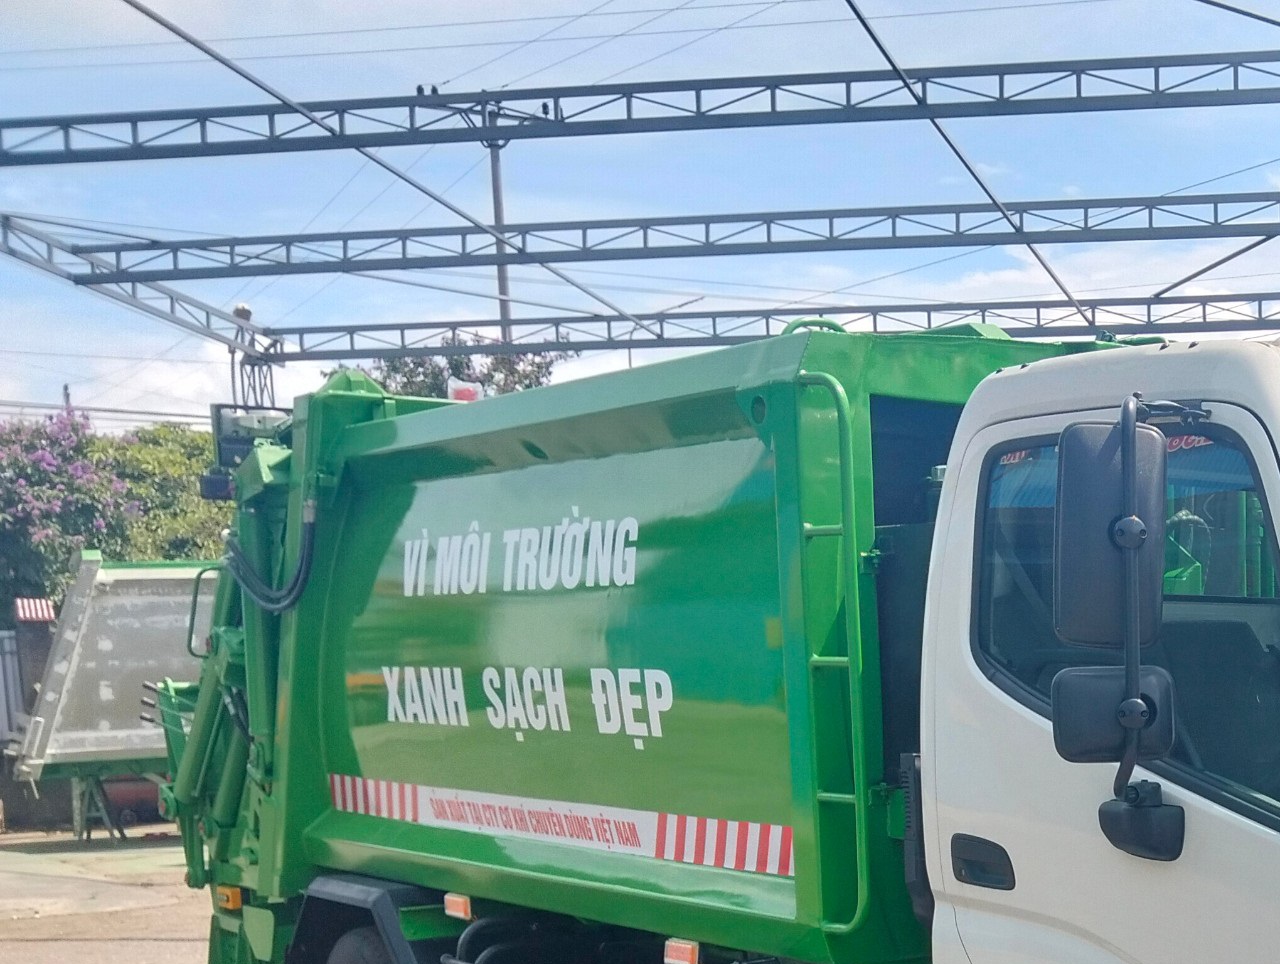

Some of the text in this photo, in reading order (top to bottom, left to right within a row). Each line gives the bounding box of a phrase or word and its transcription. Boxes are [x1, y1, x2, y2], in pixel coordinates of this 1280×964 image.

[403, 506, 639, 597] VÌ MÔI TRƯỜNG
[382, 666, 674, 750] XANH SẠCH ĐẸP
[564, 809, 594, 842] DÙNG
[591, 812, 615, 850] VIỆT
[613, 820, 642, 848] NAM
